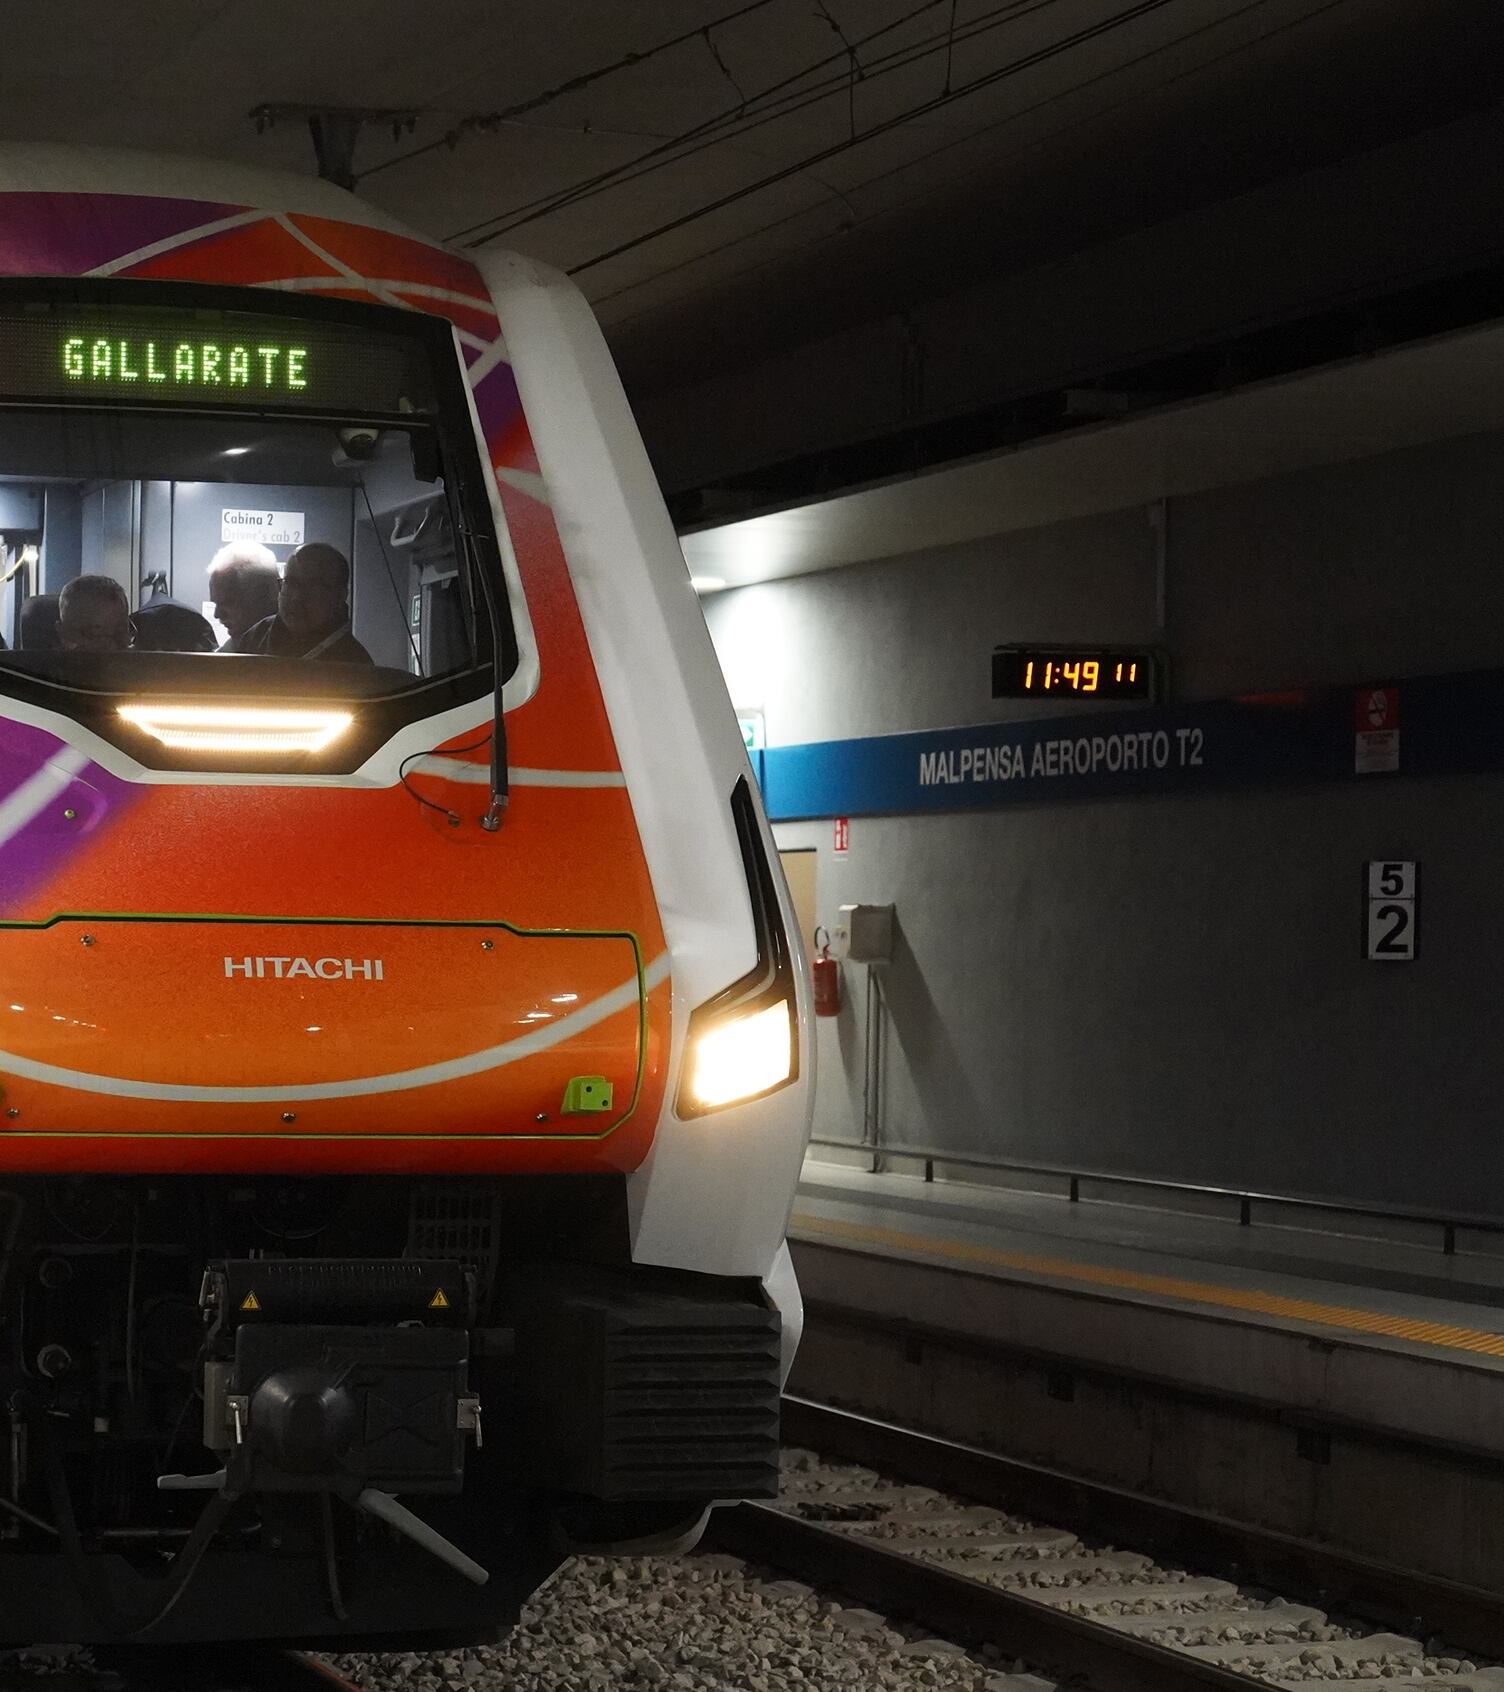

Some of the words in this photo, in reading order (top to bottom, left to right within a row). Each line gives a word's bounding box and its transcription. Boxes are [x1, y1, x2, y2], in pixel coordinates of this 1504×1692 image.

[63, 338, 307, 387] GALLARATE
[223, 511, 263, 526] Cabina
[266, 513, 274, 526] 2
[270, 530, 290, 543] cab
[293, 530, 301, 543] 2
[1025, 661, 1100, 691] 11:49
[1115, 663, 1137, 683] 11
[919, 743, 1026, 786] MALPENSA
[1030, 730, 1170, 778] AEROPORTO
[1175, 727, 1204, 767] T2
[1380, 863, 1405, 896] 5
[1376, 904, 1409, 954] 2
[223, 956, 384, 981] HITACHI
